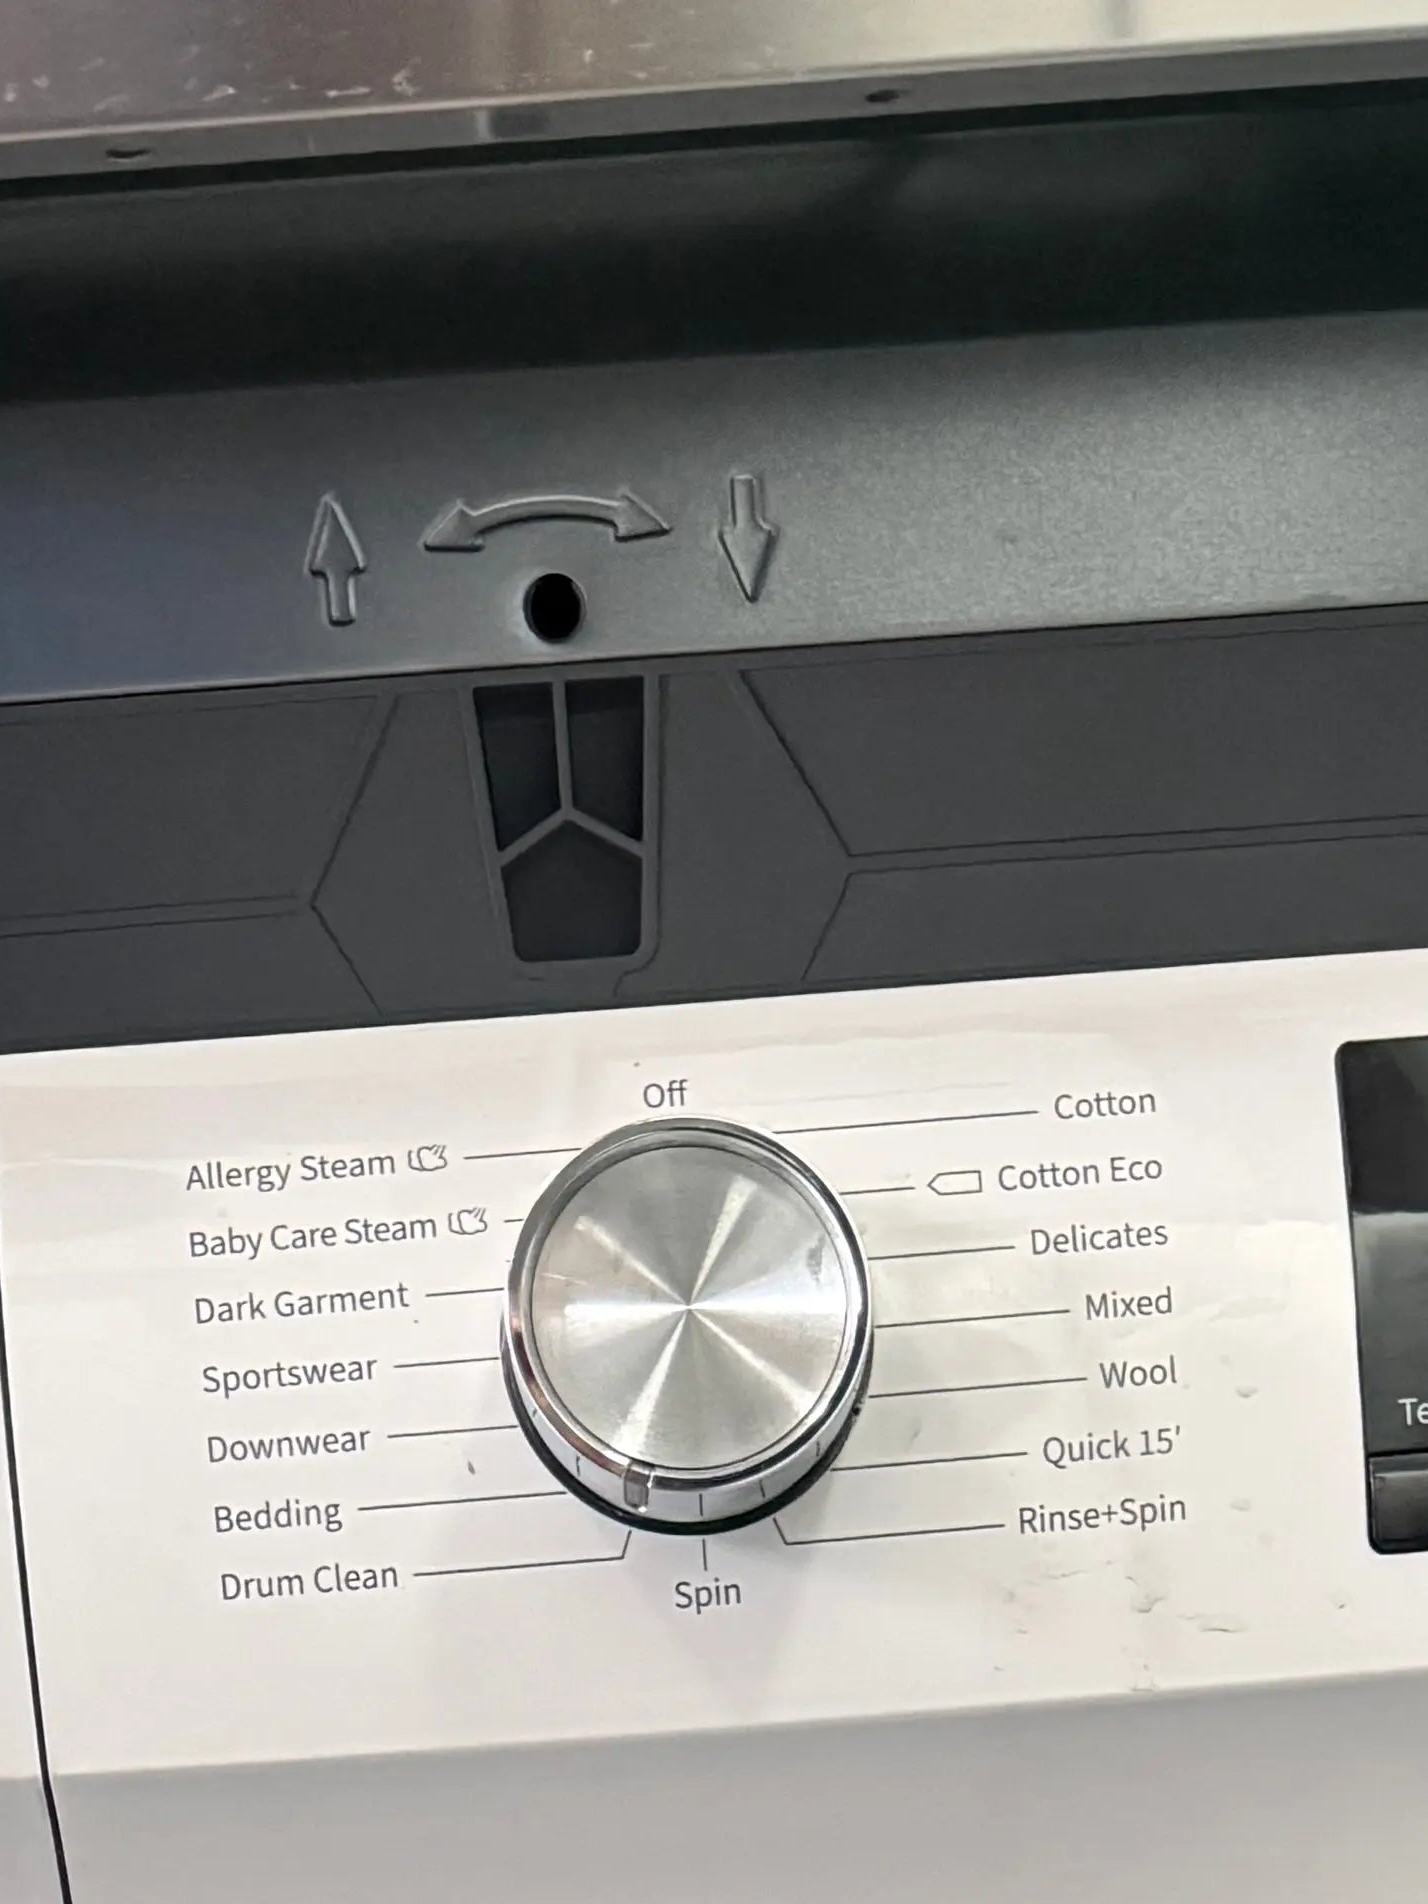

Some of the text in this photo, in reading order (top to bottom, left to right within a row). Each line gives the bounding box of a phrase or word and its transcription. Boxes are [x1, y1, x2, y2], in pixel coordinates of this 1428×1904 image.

[643, 1080, 689, 1109] Off
[1054, 1089, 1157, 1121] Cotton
[186, 1149, 396, 1195] Allergy Steam
[998, 1153, 1163, 1191] Cotton Eco
[189, 1211, 437, 1259] Baby Care Steam
[1030, 1220, 1169, 1256] Delicates
[194, 1282, 410, 1325] Dark Garment
[1085, 1287, 1172, 1320] Mixed
[203, 1354, 377, 1400] Sportswear
[1099, 1357, 1178, 1389] Wool
[206, 1426, 371, 1463] Downwear
[1043, 1426, 1183, 1469] Quick 15'
[214, 1497, 342, 1534] Bedding
[1019, 1494, 1187, 1536] Rinse+Spin
[221, 1561, 399, 1601] Drum Clean
[675, 1575, 743, 1613] Spin
